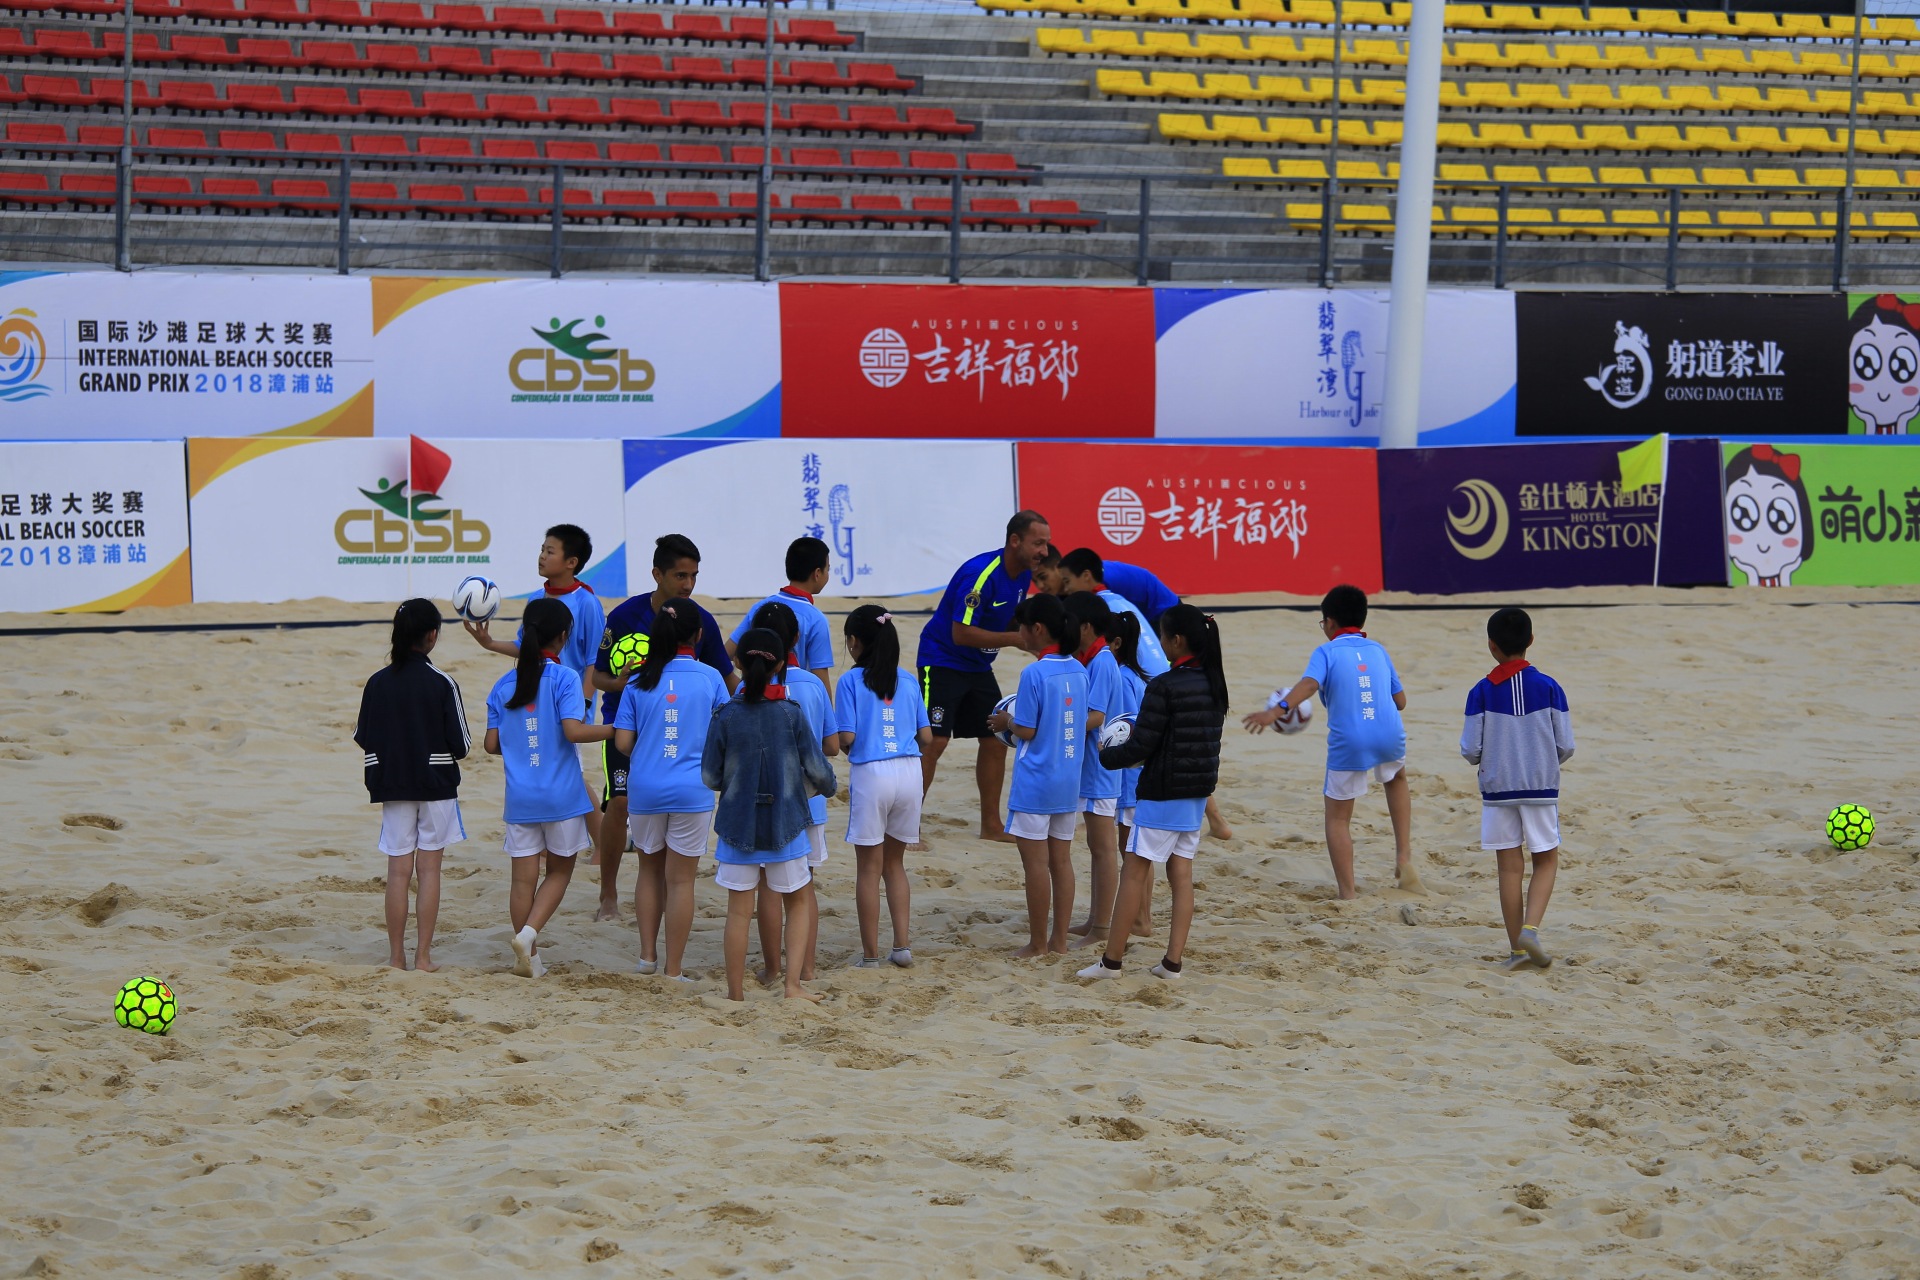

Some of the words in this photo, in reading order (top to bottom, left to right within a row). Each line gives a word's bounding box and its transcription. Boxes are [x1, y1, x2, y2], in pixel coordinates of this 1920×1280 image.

[78, 320, 333, 345] 国际沙滩足球大奖赛
[79, 348, 210, 368] INTERNATIONAL
[215, 349, 268, 368] BEACH
[273, 350, 333, 368] SOCCER
[1665, 339, 1786, 379] 躬道茶业
[79, 372, 142, 393] GRAND
[148, 372, 190, 393] PRIX
[1665, 386, 1704, 401] GONG
[1706, 387, 1734, 401] DAO
[1736, 387, 1764, 401] CHA
[1765, 387, 1784, 401] YE
[1299, 401, 1342, 418] Harbour
[0, 490, 144, 517] 足球大奖赛
[1570, 512, 1609, 523] HOTEL
[20, 521, 76, 541] BEACH
[81, 519, 146, 539] SOCCER
[1521, 522, 1660, 551] KINGSTON
[403, 555, 426, 564] BACH
[525, 717, 540, 767] 翡翠湾
[664, 708, 679, 759] 翡翠湾
[882, 708, 898, 753] 翡翠湾
